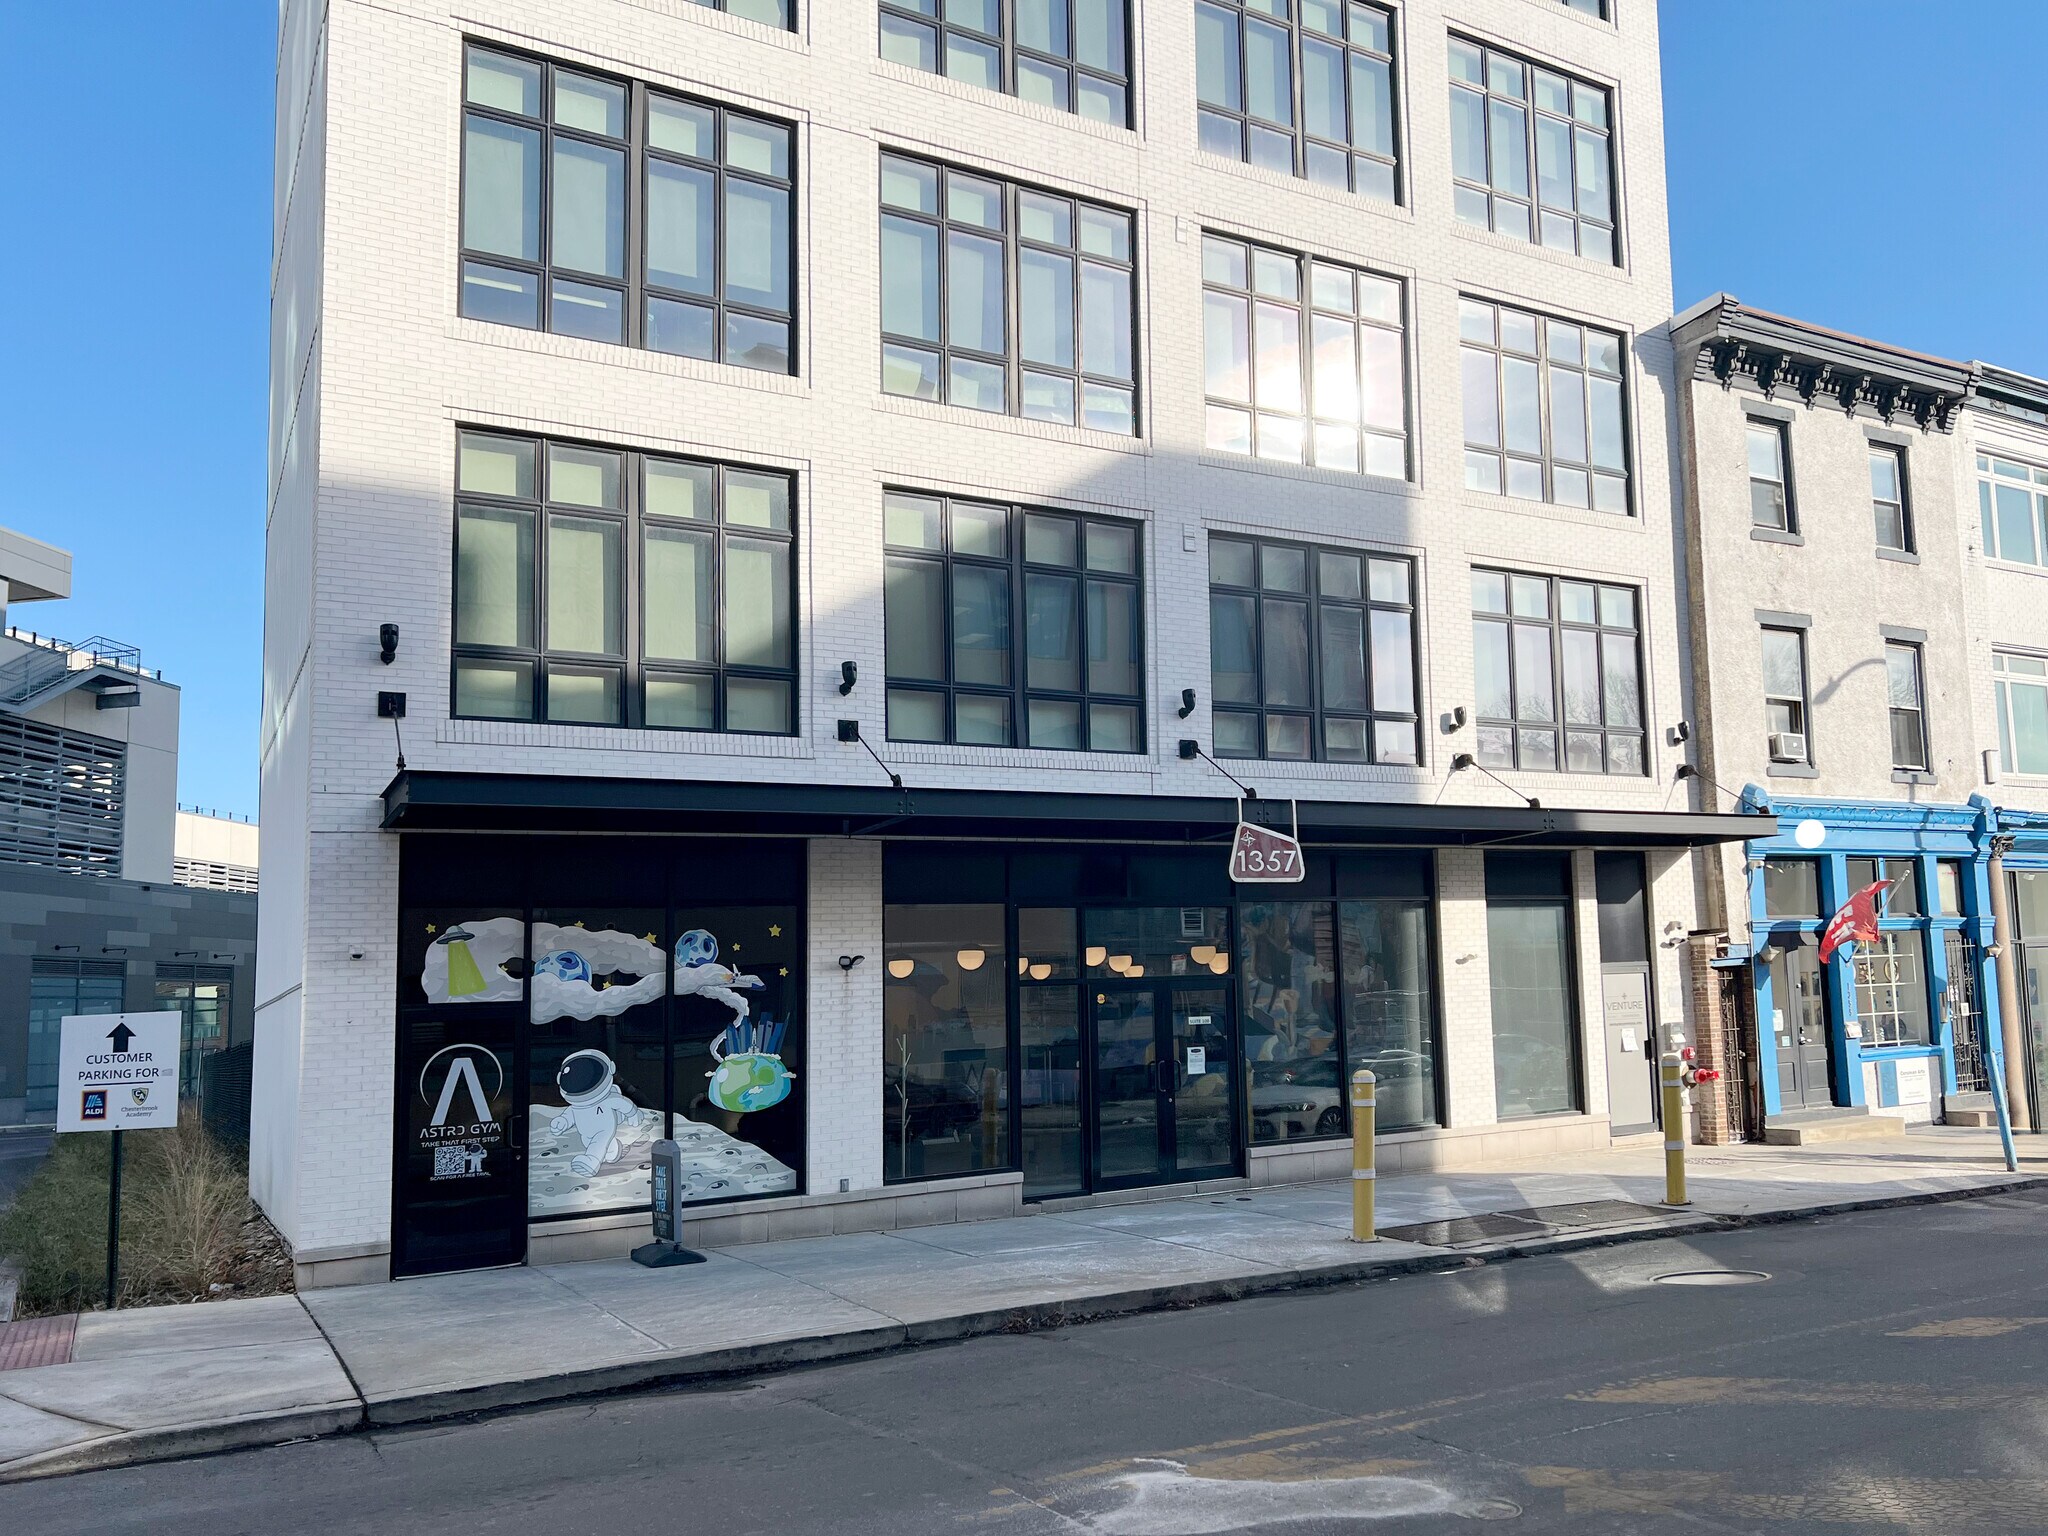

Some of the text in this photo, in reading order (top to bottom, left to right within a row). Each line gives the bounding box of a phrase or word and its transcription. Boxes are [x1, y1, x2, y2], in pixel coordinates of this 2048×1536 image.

[1237, 850, 1297, 872] 1357
[1606, 1001, 1643, 1011] VENTURE
[86, 1052, 153, 1065] CUSTOMER
[78, 1067, 160, 1081] PARKING FOR
[419, 1122, 502, 1139] ASTRO GYM
